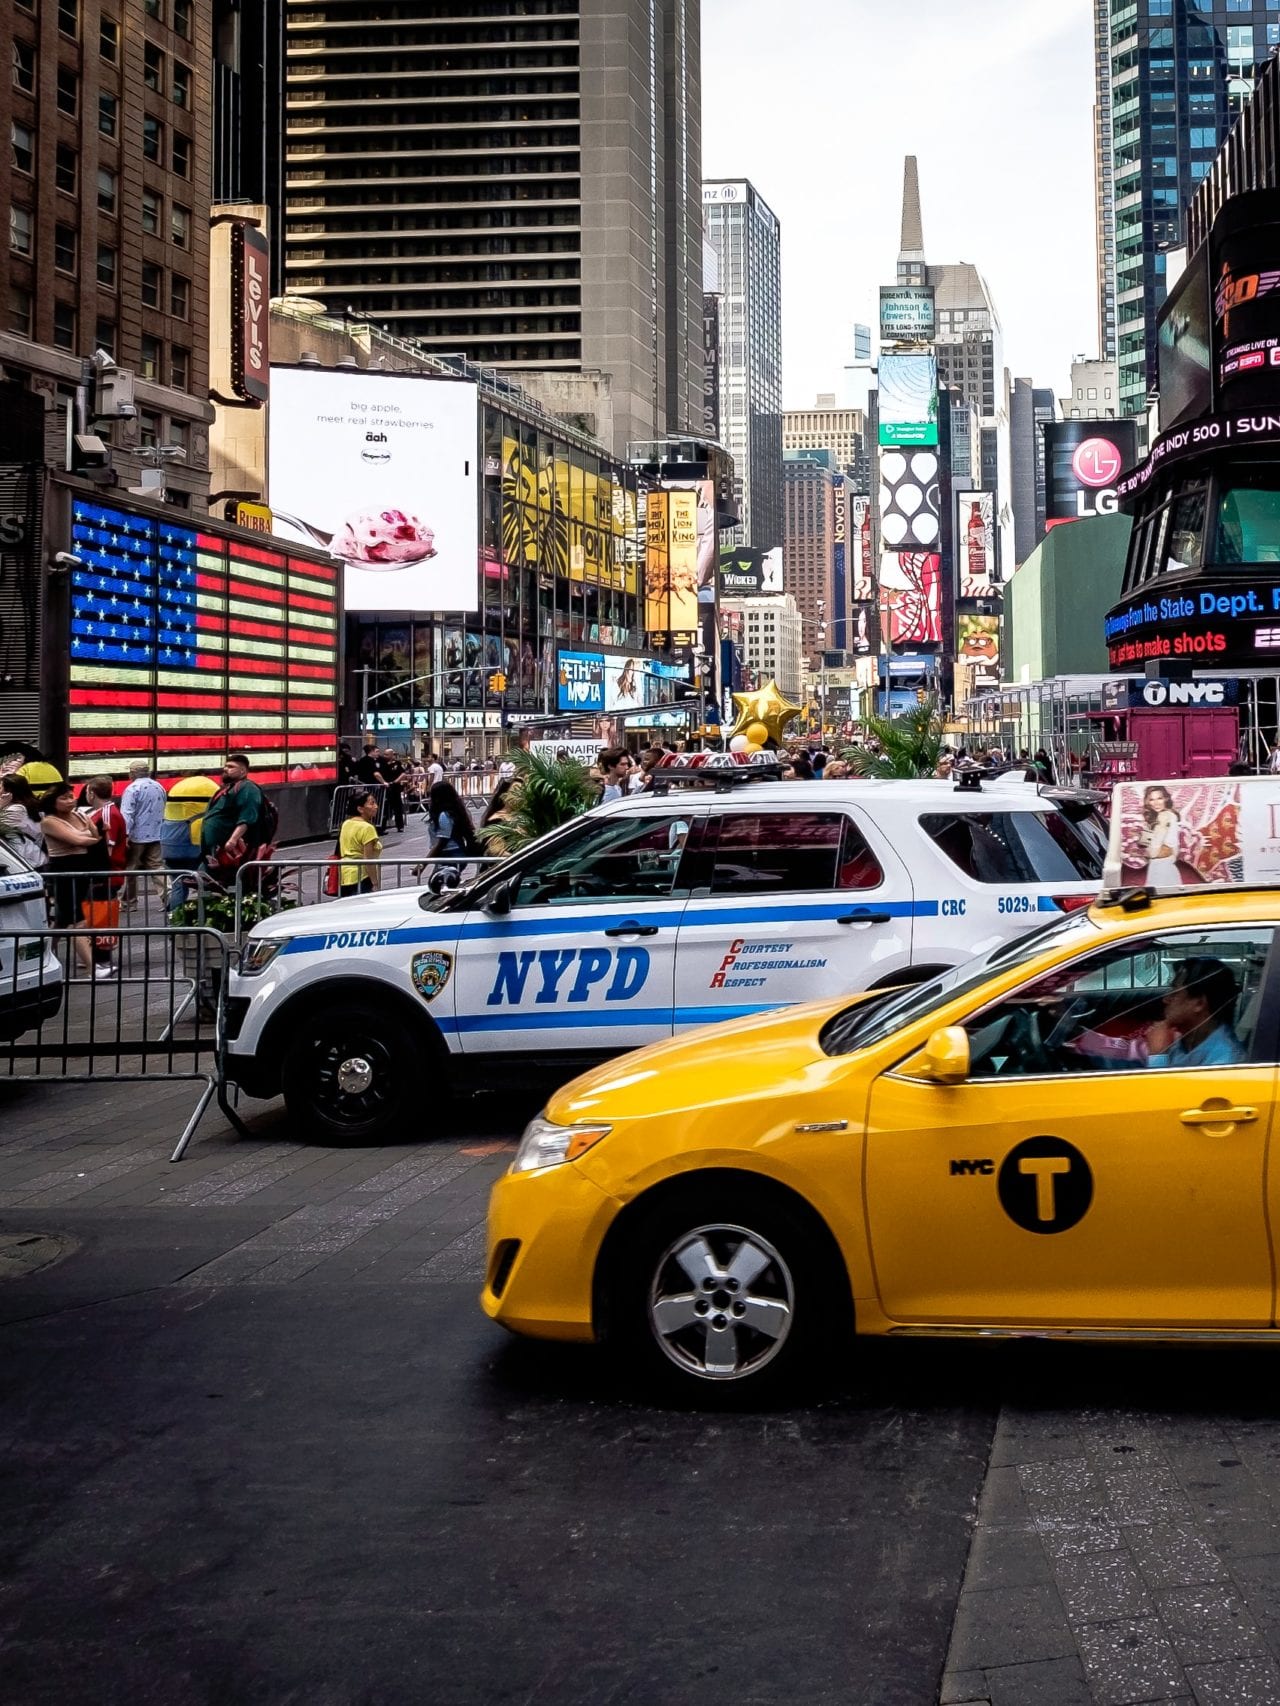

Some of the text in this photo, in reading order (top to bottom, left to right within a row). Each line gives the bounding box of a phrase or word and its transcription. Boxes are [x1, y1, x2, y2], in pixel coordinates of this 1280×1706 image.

[885, 302, 919, 312] Johnson
[1251, 339, 1266, 351] LIVE
[1266, 338, 1278, 347] ON
[703, 317, 716, 396] TIMES
[350, 401, 402, 414] big apple,
[316, 415, 435, 430] meet real strawberries
[365, 431, 388, 443] äah
[1166, 430, 1190, 453] INDY
[1192, 423, 1220, 442] 500
[1076, 489, 1119, 517] LG
[239, 510, 272, 533] BUBBA
[834, 483, 845, 543] NOVOTEL
[672, 531, 696, 543] KING
[724, 573, 757, 585] WICKED
[1144, 602, 1158, 622] the
[1160, 598, 1195, 621] State
[1199, 590, 1265, 617] Dept.
[1144, 635, 1170, 657] make
[1173, 630, 1227, 654] shots
[1169, 682, 1225, 703] NYC
[534, 744, 601, 755] VISIONAIRE
[941, 899, 966, 916] CRC
[998, 896, 1029, 914] 5029
[326, 930, 388, 950] POLICE
[729, 938, 793, 955] COURTESY
[719, 955, 827, 972] PROFESSIONALISM
[486, 946, 652, 1006] NYPD
[709, 972, 767, 989] RESPECT
[950, 1158, 995, 1176] NYC
[1018, 1157, 1071, 1222] T
